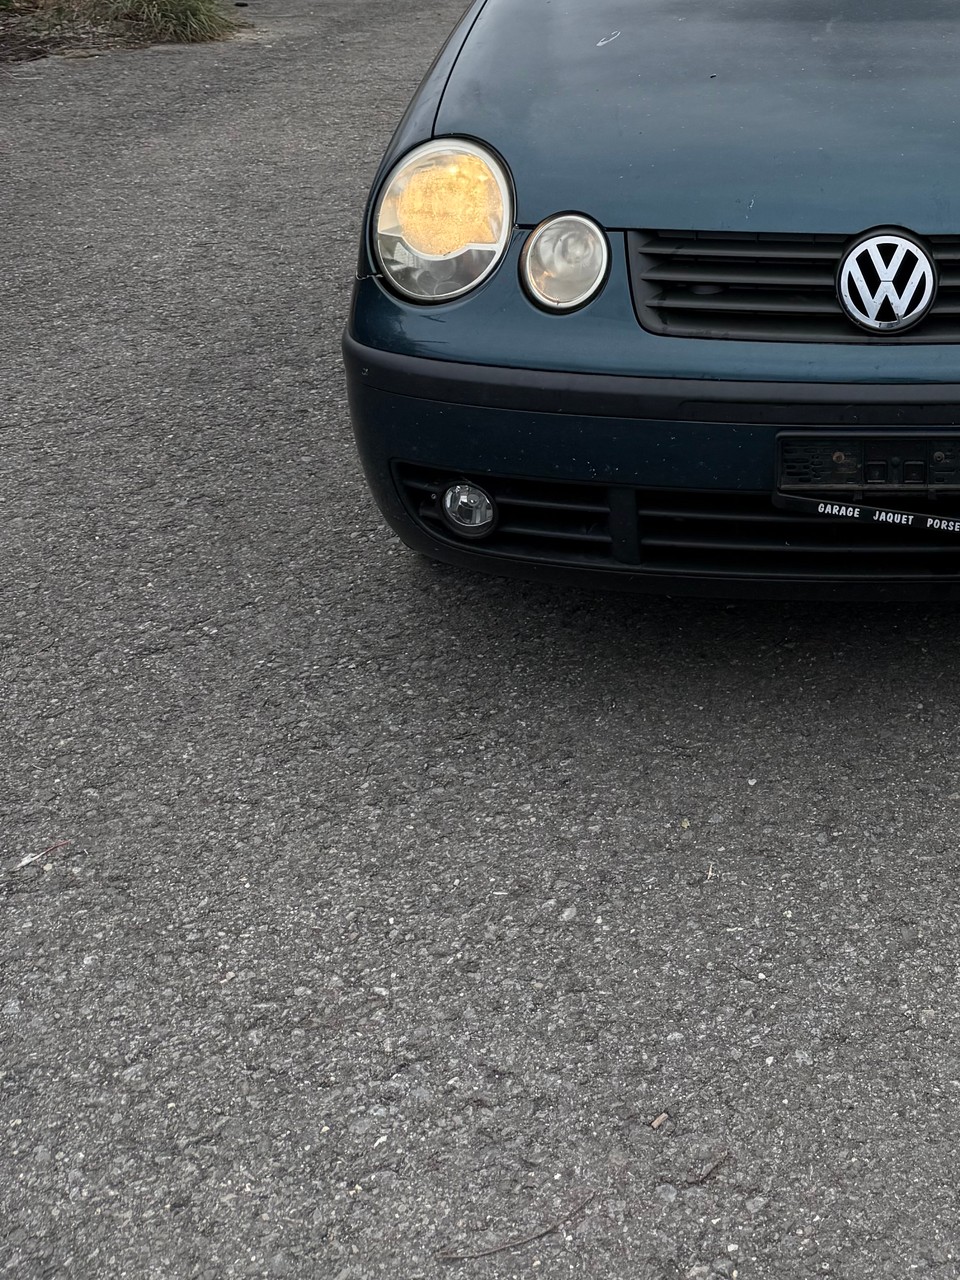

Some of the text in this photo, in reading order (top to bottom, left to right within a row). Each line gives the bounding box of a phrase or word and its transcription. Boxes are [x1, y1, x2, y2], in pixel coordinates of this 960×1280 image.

[842, 236, 932, 328] VW
[817, 503, 861, 518] GARAGE
[872, 510, 914, 525] JAQUET
